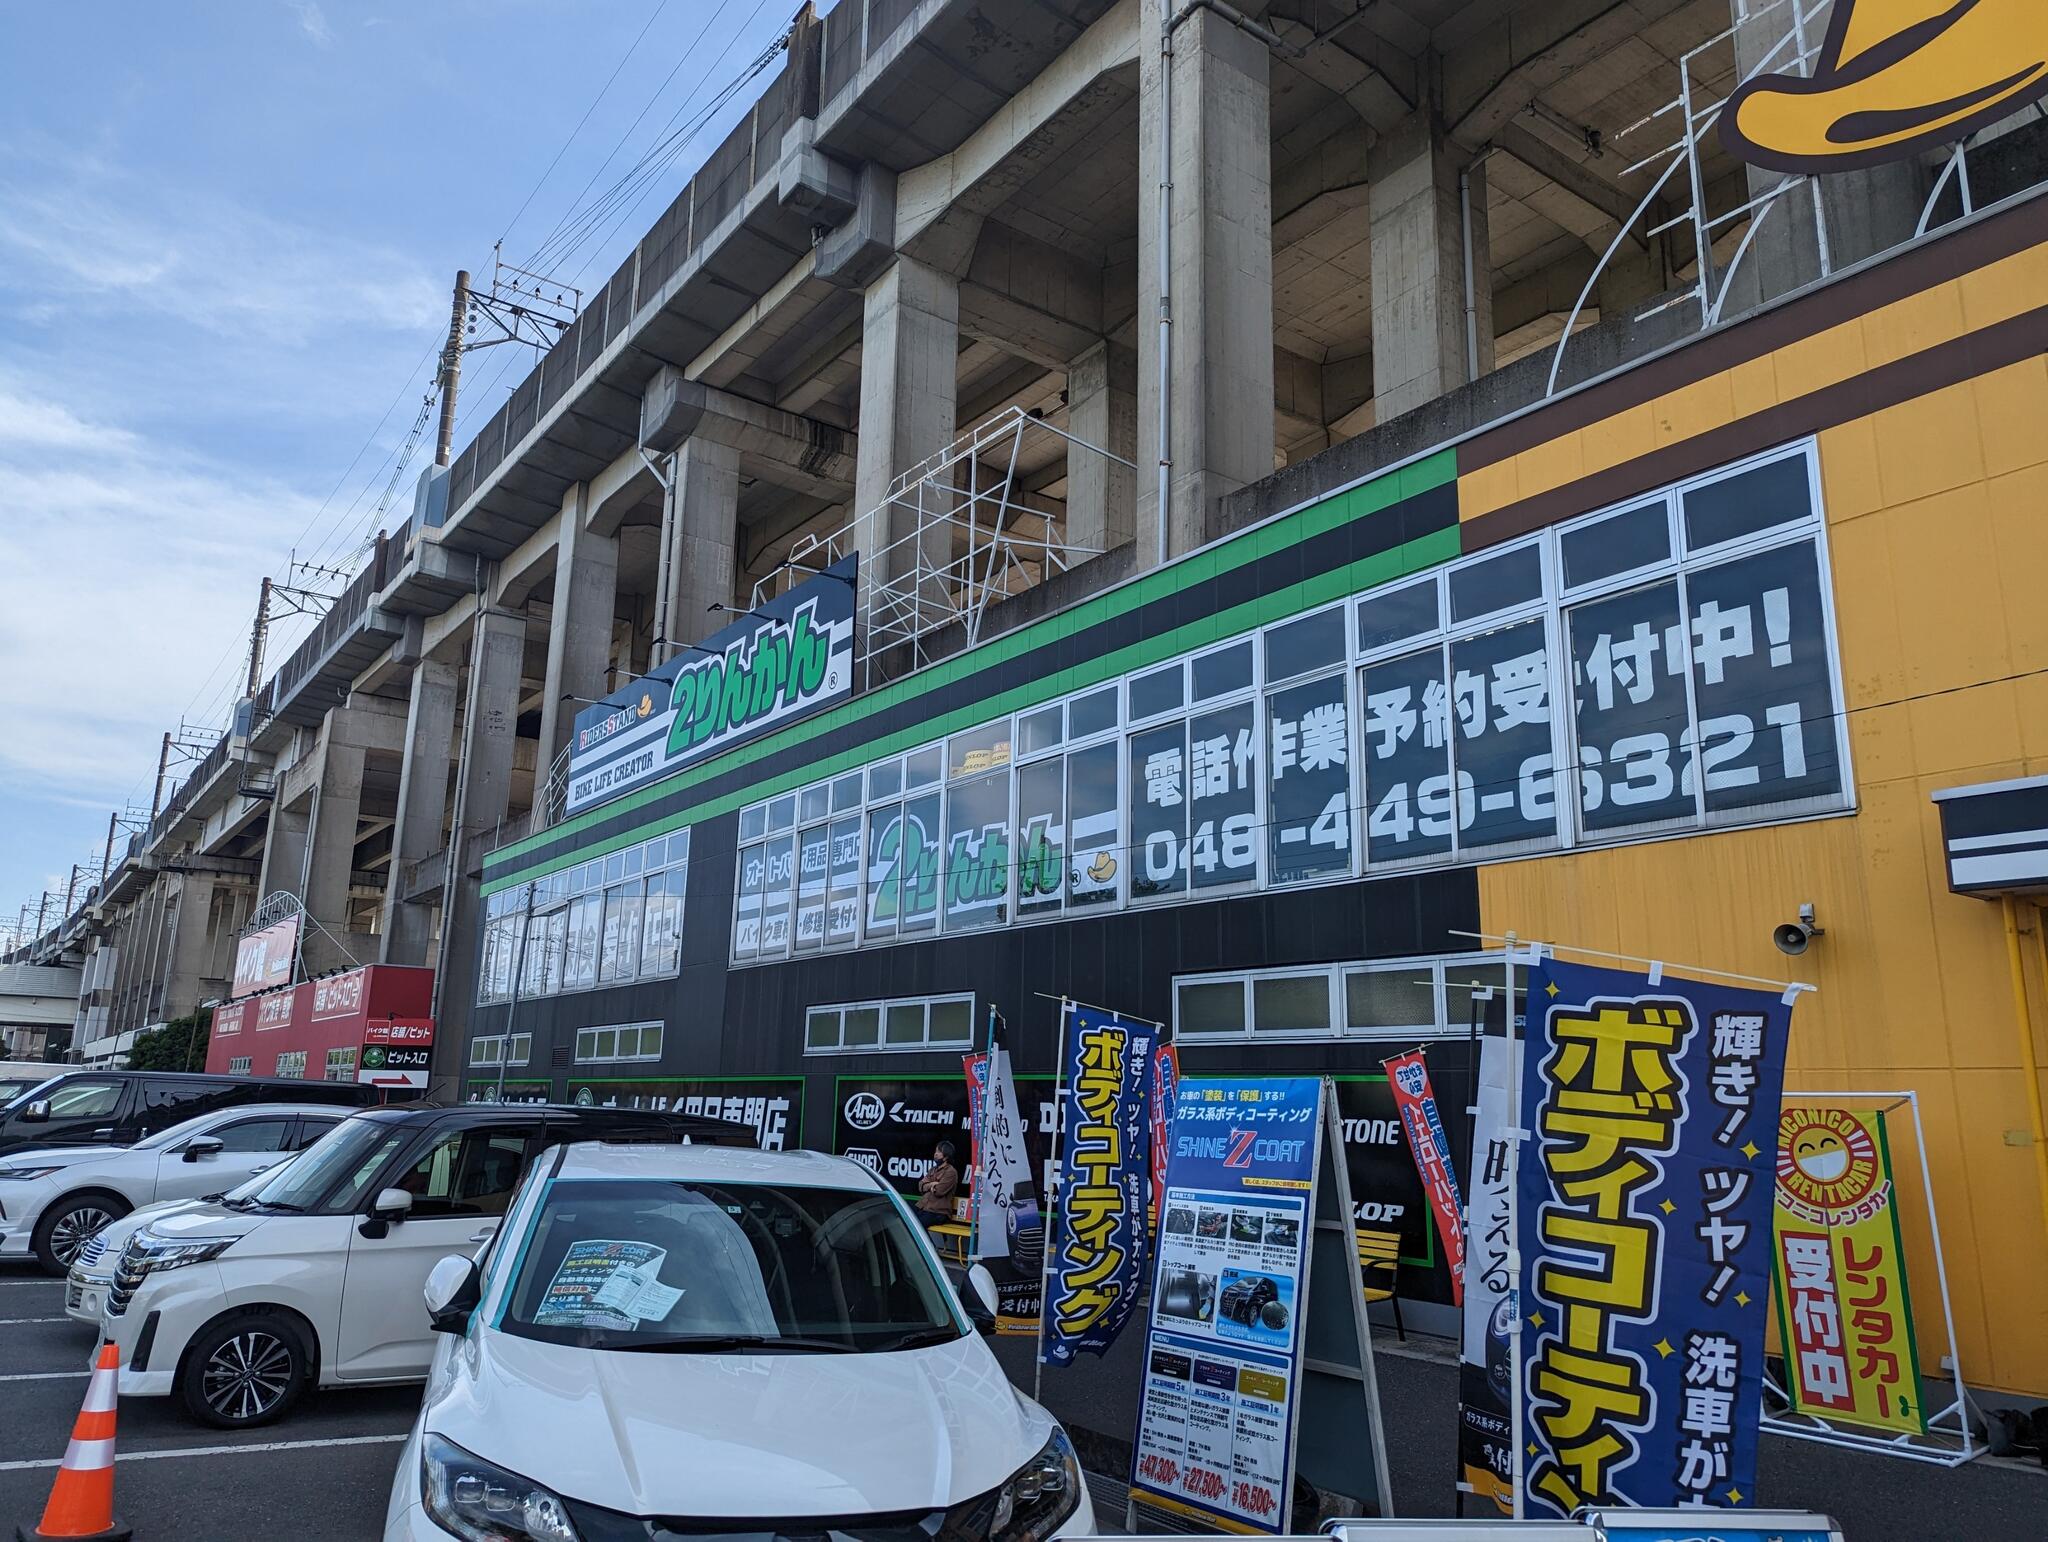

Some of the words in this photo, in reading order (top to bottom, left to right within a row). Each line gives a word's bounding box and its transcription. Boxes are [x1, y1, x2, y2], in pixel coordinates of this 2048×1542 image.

[665, 600, 832, 760] 2りんかん
[575, 776, 593, 801] BIKE
[594, 770, 612, 792] LIFE
[614, 751, 654, 787] CREATOR
[1144, 702, 1808, 881] 048-449-6321
[872, 813, 1065, 924] 2りんかん
[1129, 1036, 1151, 1093] 輝き!
[1709, 1012, 1765, 1146] 輝き!
[848, 1097, 881, 1119] Arai
[903, 1110, 954, 1124] TAICHI
[1126, 1103, 1142, 1161] ツヤ!
[1177, 1105, 1313, 1123] ガラス系ボディコーティング
[1341, 1118, 1400, 1145] TONE
[1176, 1136, 1226, 1158] SHINE
[1223, 1130, 1257, 1168] Z
[1254, 1140, 1306, 1163] COAT
[1057, 1027, 1129, 1338] ボディコーティング
[1790, 1160, 1873, 1203] RENTACAR
[1352, 1200, 1405, 1222] LOP
[1699, 1168, 1750, 1304] ツヤ!
[1154, 1335, 1169, 1343] MENU
[1784, 1236, 1849, 1405] 受付中
[1841, 1236, 1899, 1418] レンタカー
[1466, 1411, 1511, 1436] ガラス系ボディ
[1677, 1333, 1739, 1508] 洗車が
